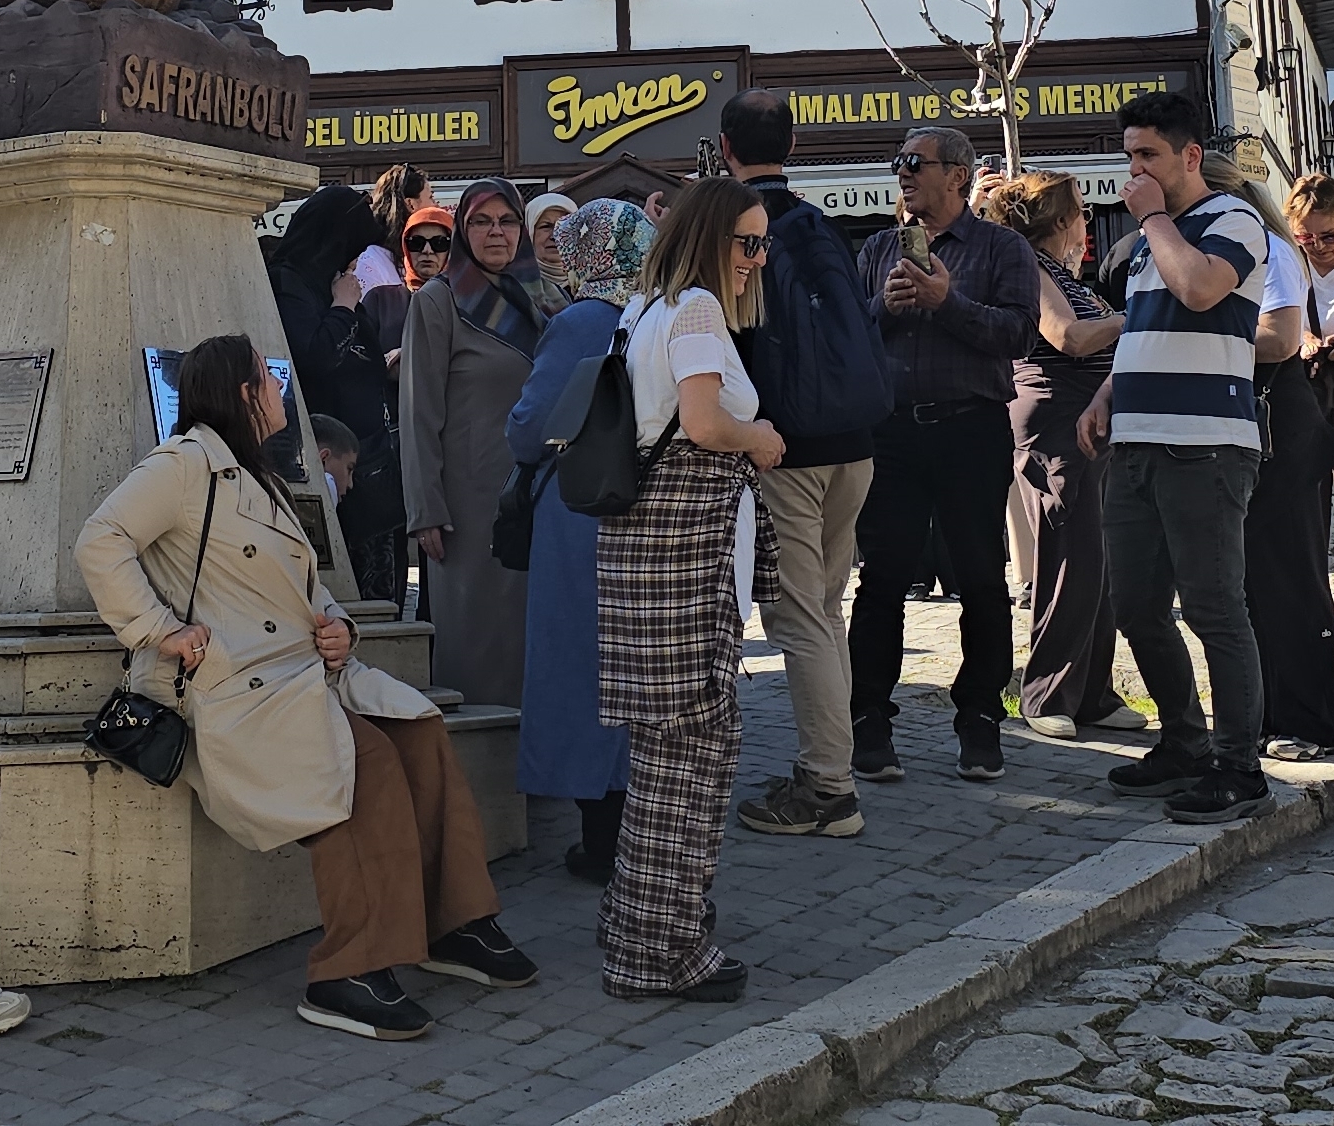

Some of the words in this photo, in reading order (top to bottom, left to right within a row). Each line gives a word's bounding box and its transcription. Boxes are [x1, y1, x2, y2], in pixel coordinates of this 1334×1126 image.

[122, 54, 299, 142] SAFRANBOLU
[353, 108, 479, 145] ÜRÜNLER
[547, 74, 707, 154] İmren
[789, 90, 901, 125] İMALATI
[908, 95, 941, 120] ve
[950, 88, 1030, 121] STŞ
